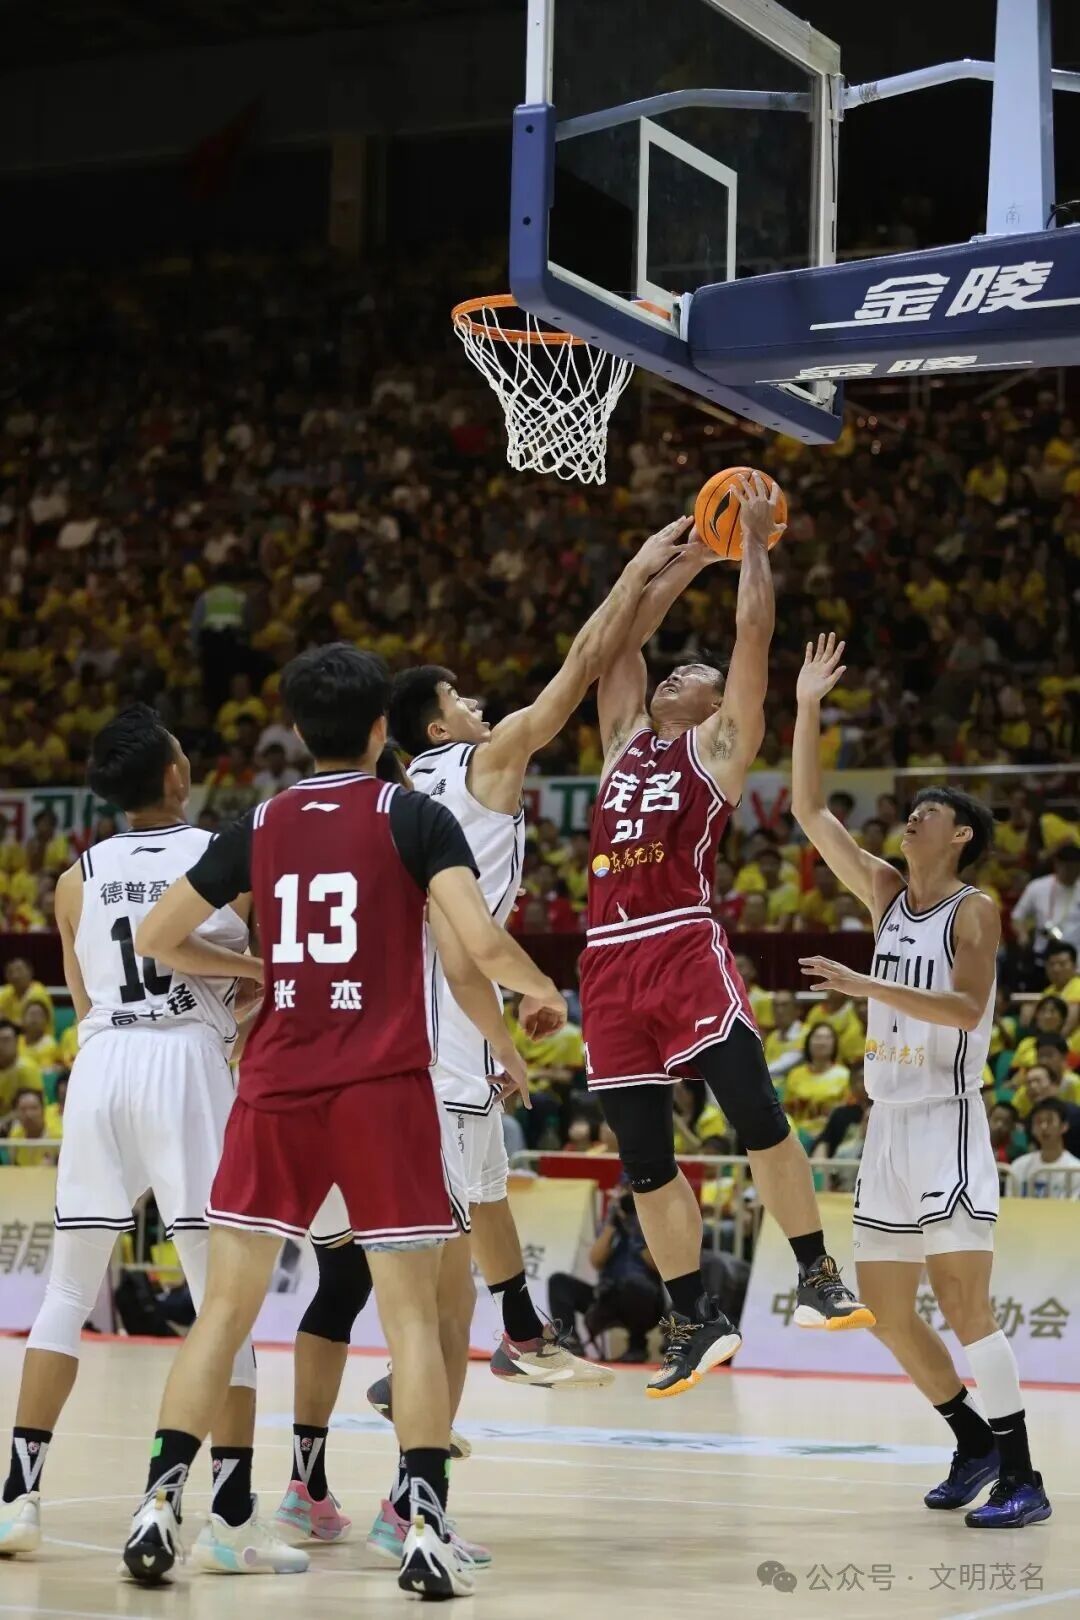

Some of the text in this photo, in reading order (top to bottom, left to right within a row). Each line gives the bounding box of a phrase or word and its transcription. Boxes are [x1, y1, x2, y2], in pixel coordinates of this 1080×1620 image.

[853, 260, 1055, 322] 金陵
[602, 769, 682, 814] 茂名
[611, 818, 644, 844] 21
[272, 871, 359, 964] 13
